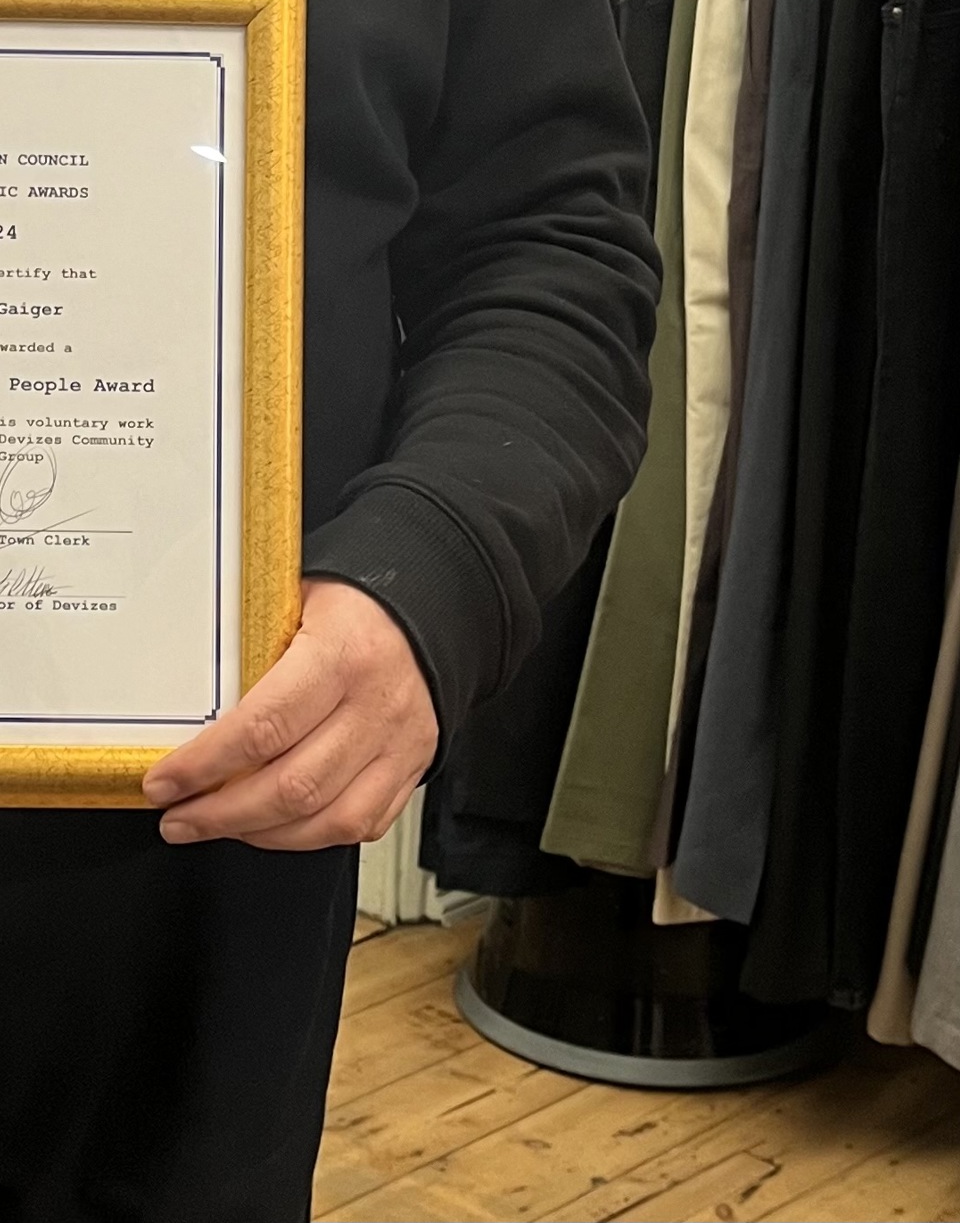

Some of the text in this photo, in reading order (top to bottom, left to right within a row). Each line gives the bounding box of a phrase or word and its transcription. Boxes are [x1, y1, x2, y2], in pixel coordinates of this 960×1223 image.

[17, 153, 90, 167] COUNCIL
[27, 186, 89, 199] AWARDS
[61, 267, 97, 279] that
[63, 344, 73, 353] a
[9, 377, 82, 396] People
[92, 378, 156, 393] Award
[25, 416, 109, 432] voluntary
[117, 417, 155, 429] work
[71, 433, 155, 449] Community
[43, 534, 91, 546] Clerk
[24, 599, 43, 611] of
[52, 600, 117, 611] Devizes
